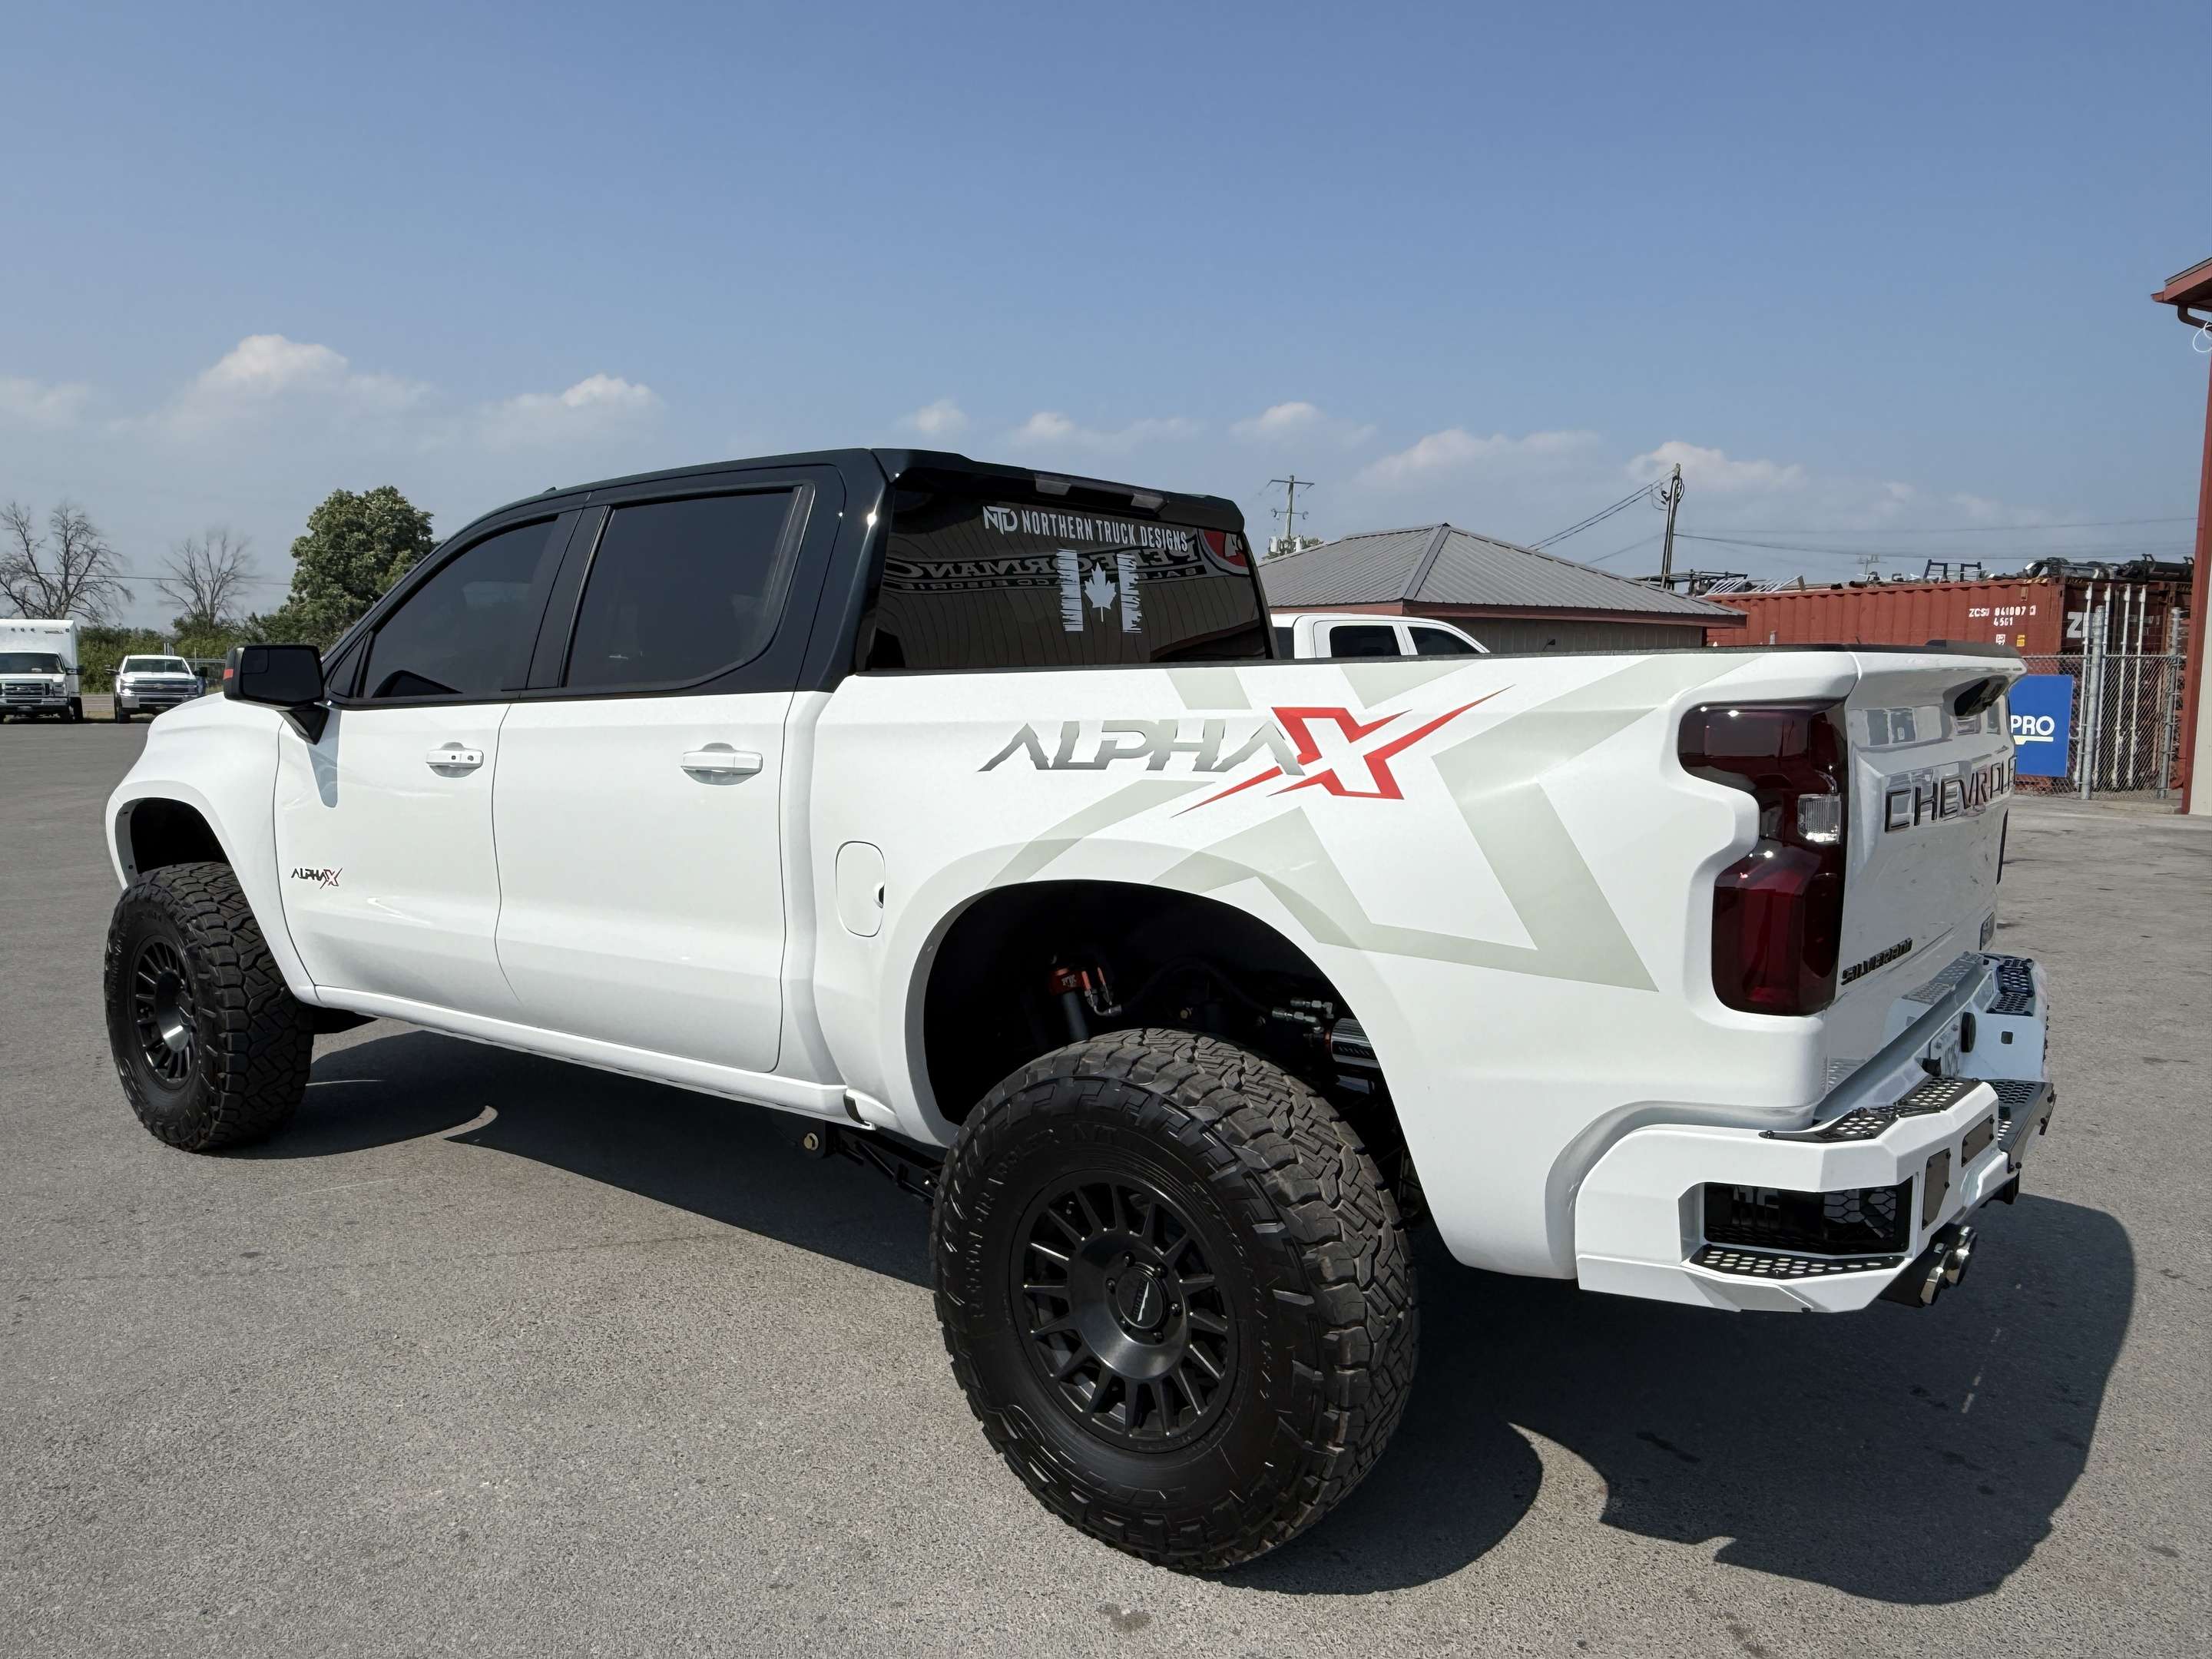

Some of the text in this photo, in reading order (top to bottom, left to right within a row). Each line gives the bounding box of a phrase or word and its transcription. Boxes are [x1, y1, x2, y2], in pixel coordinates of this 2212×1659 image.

[1022, 509, 1093, 541] NORTHERN
[1096, 519, 1137, 545] TRUCK
[1140, 525, 1187, 551] DESIGNS
[2010, 714, 2055, 736] PRO
